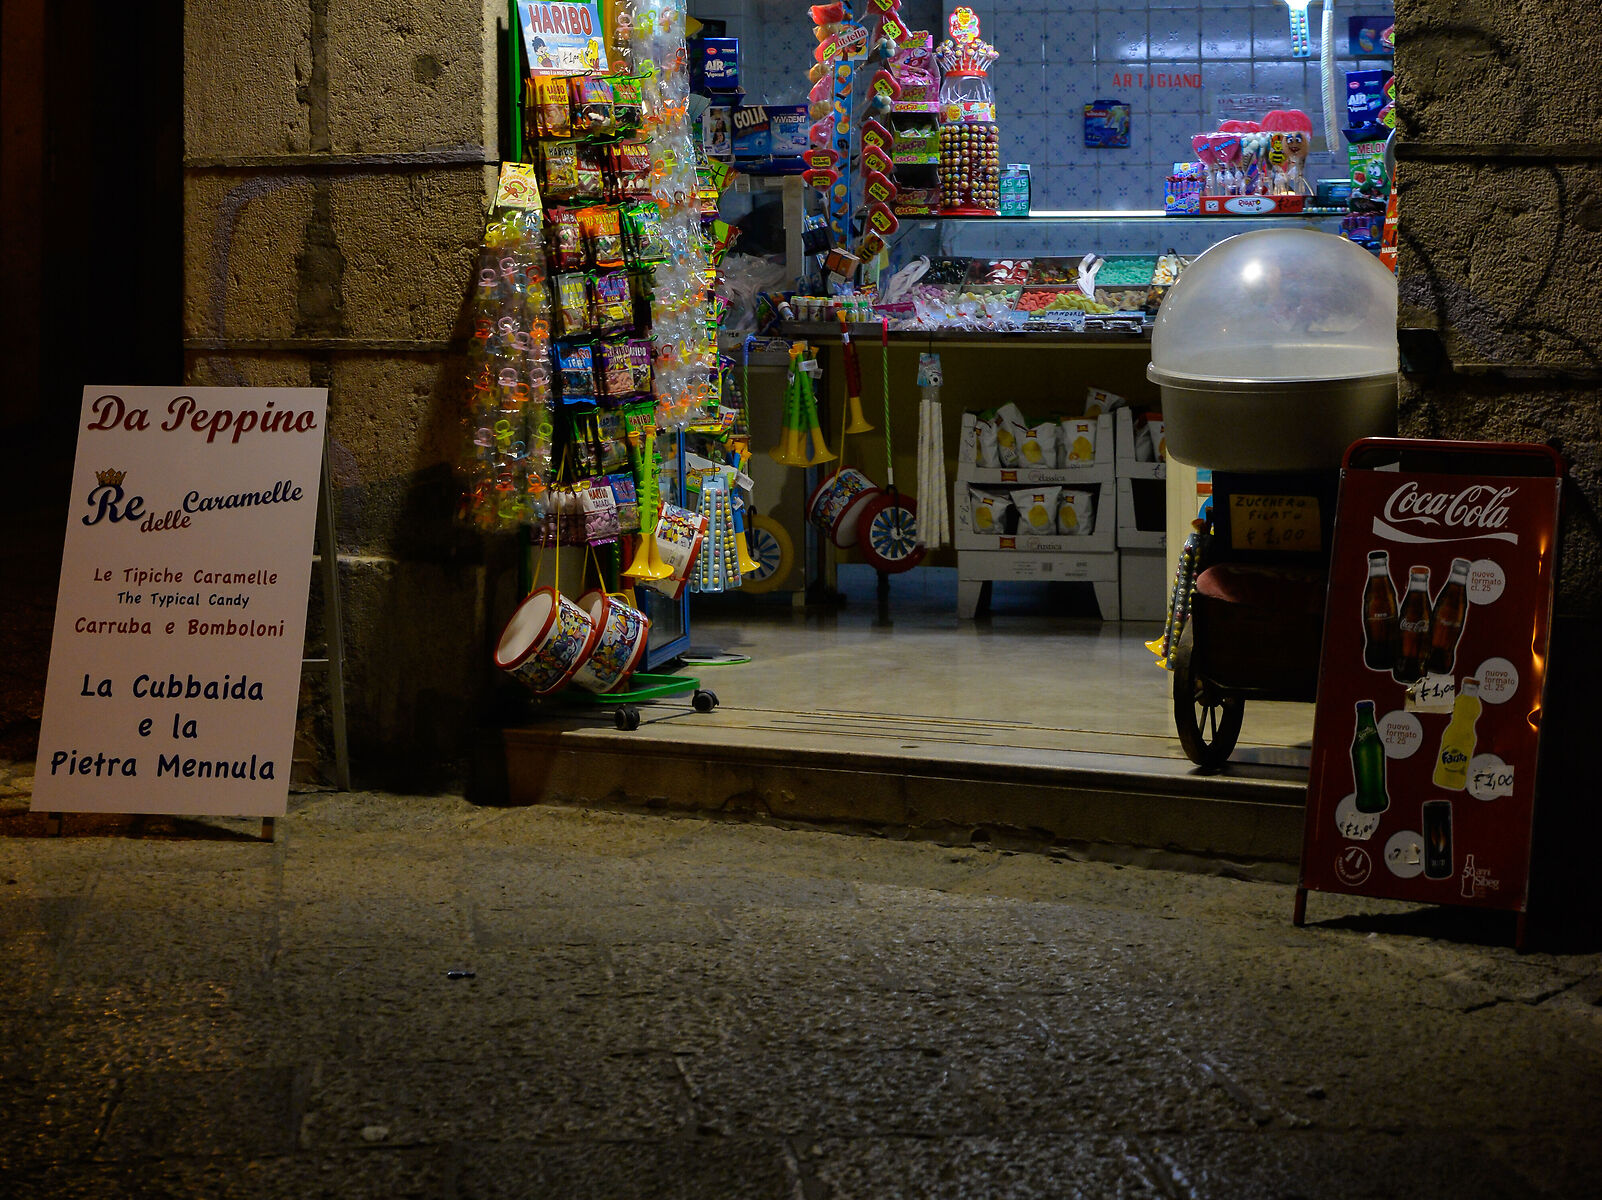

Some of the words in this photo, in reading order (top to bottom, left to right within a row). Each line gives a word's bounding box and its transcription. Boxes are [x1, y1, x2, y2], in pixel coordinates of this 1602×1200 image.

[528, 5, 593, 36] HARIBO
[1112, 73, 1202, 88] ARTIGIANO
[1002, 179, 1013, 188] 45
[1016, 179, 1027, 188] 45
[87, 395, 150, 432] Da
[161, 395, 318, 444] Peppino
[82, 484, 146, 527] Re
[140, 510, 191, 533] delle
[182, 480, 304, 514] Caramelle
[1384, 481, 1520, 528] Coca-Cola
[94, 568, 113, 584] Le
[123, 568, 184, 587] Tipiche
[193, 569, 279, 586] Caramelle
[1471, 577, 1502, 586] formato
[1482, 584, 1491, 592] 25
[117, 592, 142, 606] The
[150, 593, 200, 609] Typical
[208, 593, 250, 610] Candy
[75, 617, 152, 636] Carruba
[165, 623, 175, 635] e
[188, 618, 285, 638] Bomboloni
[80, 674, 113, 698] La
[132, 674, 265, 701] Cubbaida
[1484, 677, 1515, 685] formato
[138, 719, 153, 738] e
[172, 714, 198, 739] la
[1386, 730, 1417, 738] formato
[1387, 723, 1410, 731] nuovo
[51, 751, 137, 777] Pietra
[157, 753, 275, 780] Mennula
